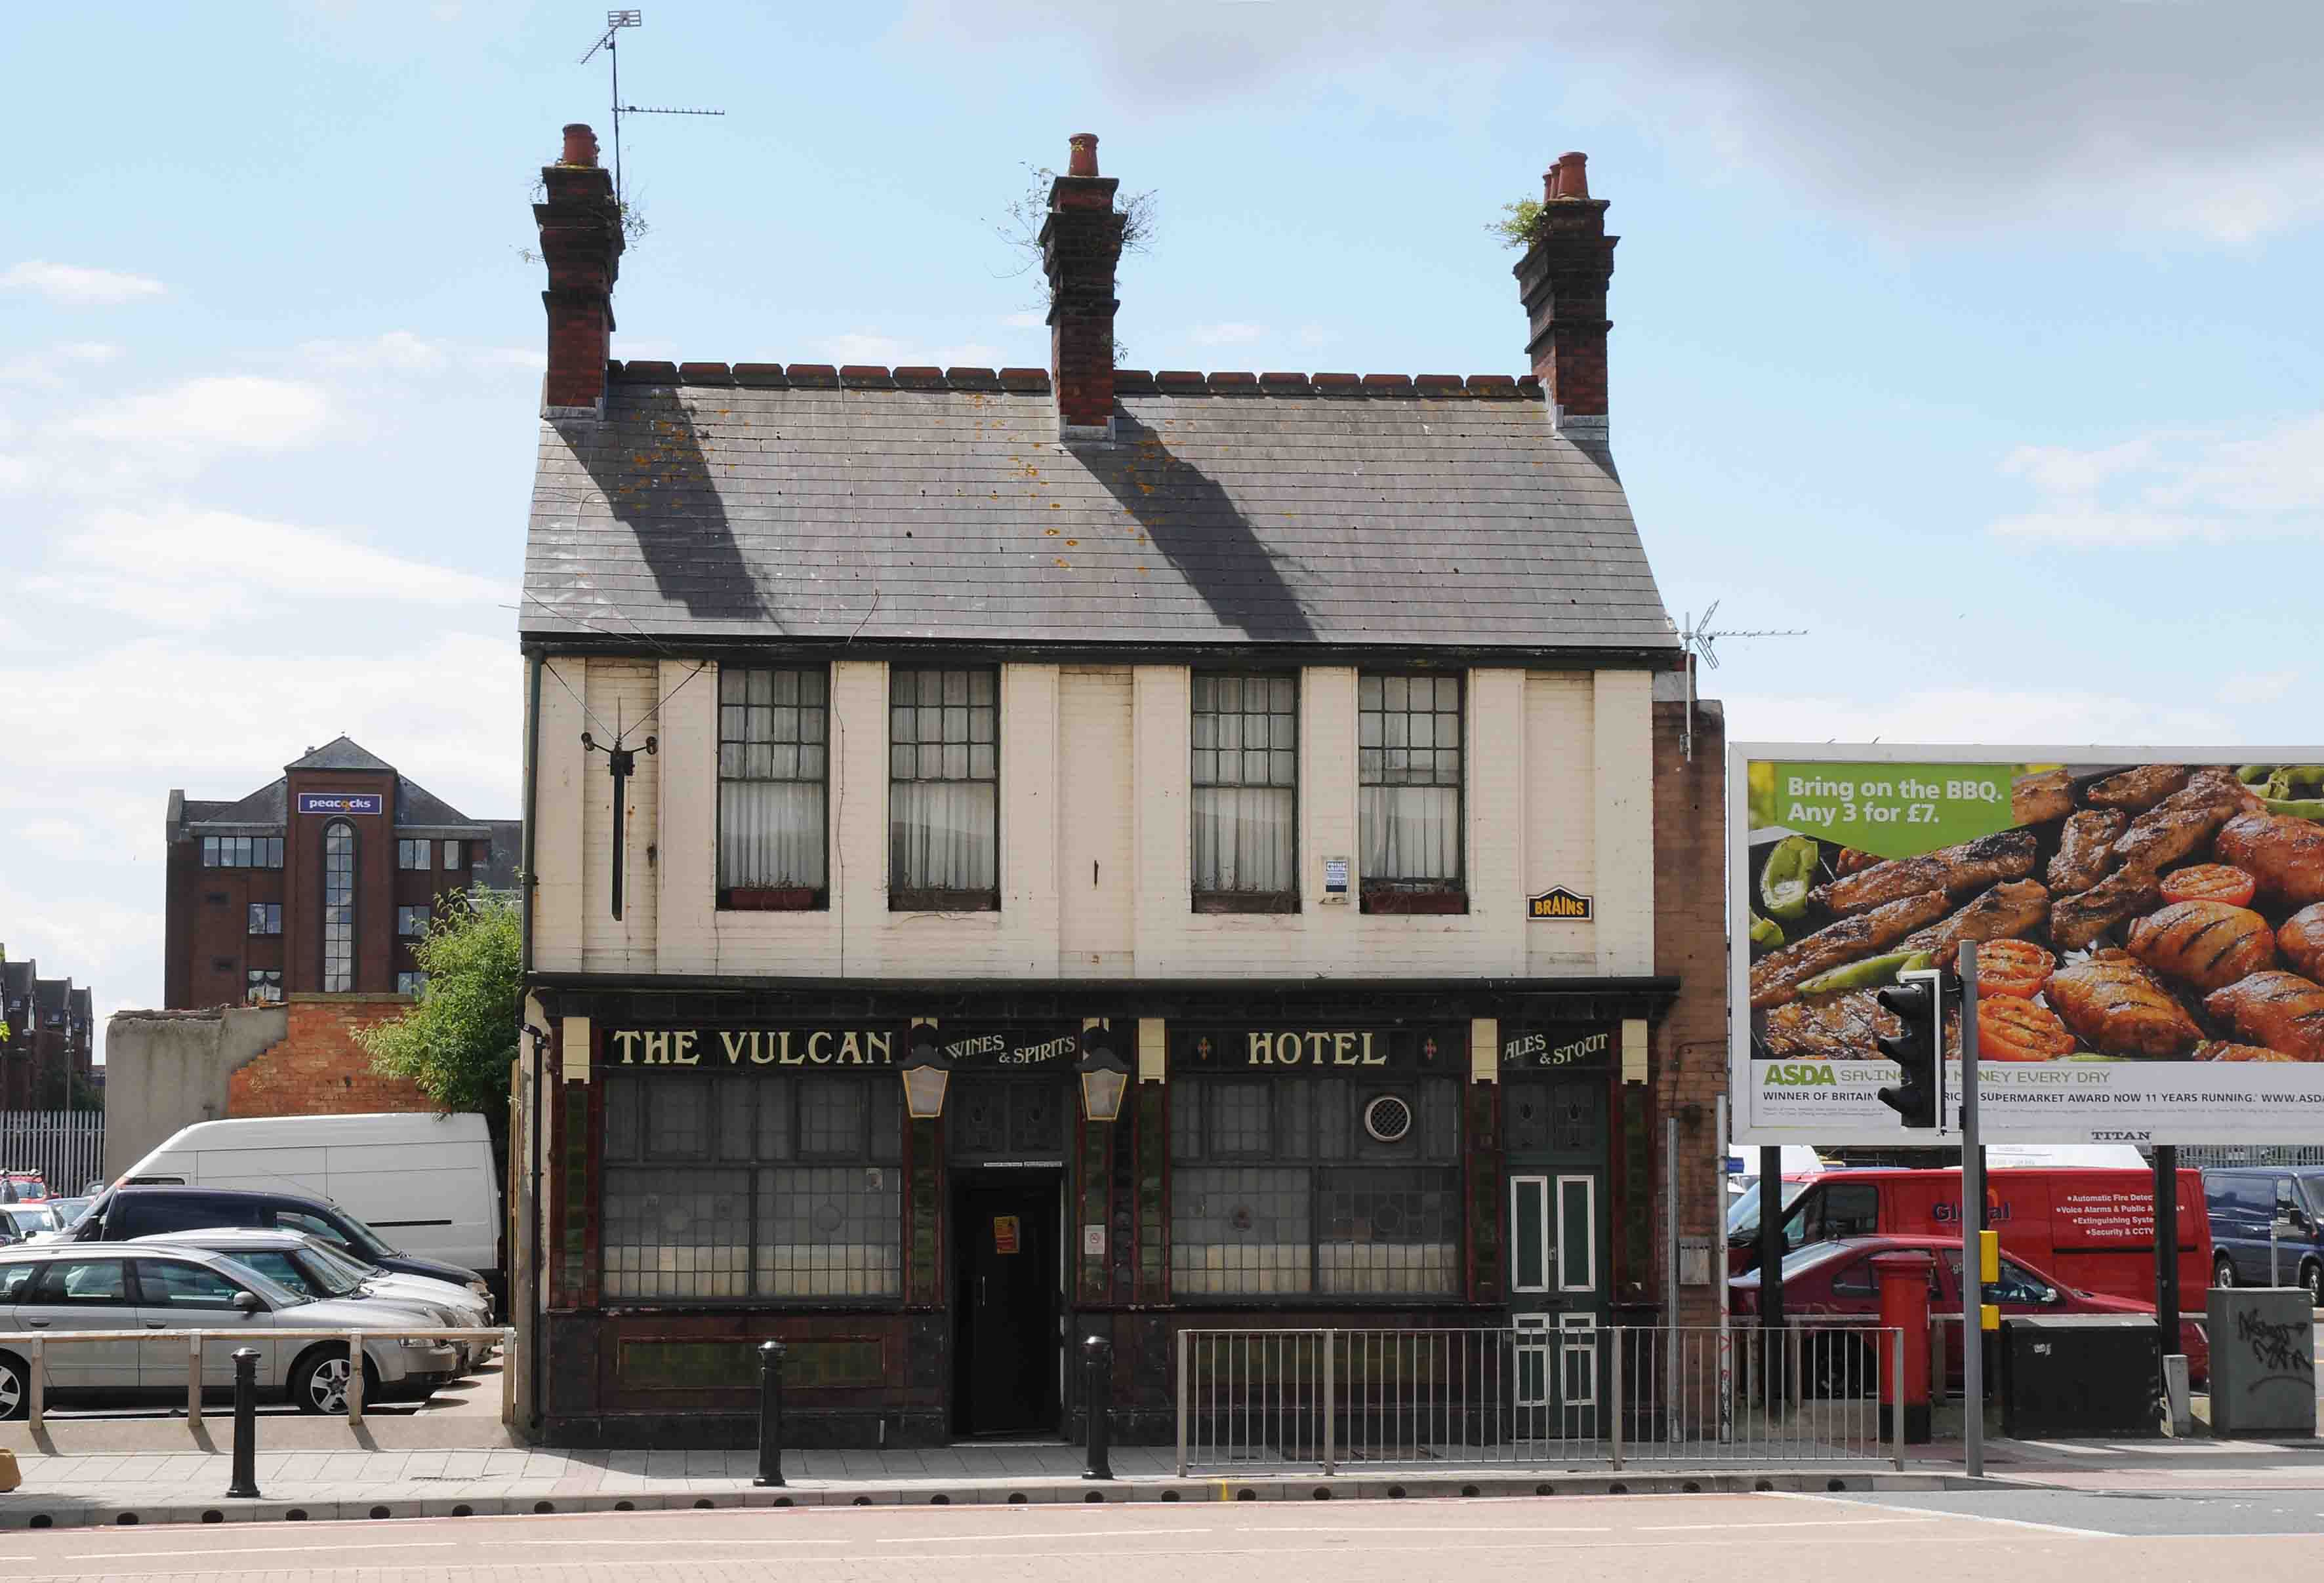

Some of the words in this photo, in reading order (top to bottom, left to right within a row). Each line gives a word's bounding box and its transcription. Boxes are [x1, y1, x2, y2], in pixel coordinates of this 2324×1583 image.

[1787, 777, 1854, 802] Bring
[1861, 783, 1892, 797] on
[1899, 780, 1940, 799] the
[1946, 781, 2003, 803] BBQ.
[309, 799, 371, 811] peacocks
[1787, 803, 1837, 826] Any
[1843, 804, 1857, 822] 3
[1863, 803, 1900, 822] for
[1907, 804, 1939, 823] £7.
[1535, 895, 1585, 915] BRAINS
[614, 1030, 701, 1066] THE
[720, 1031, 893, 1066] VULCAN
[945, 1034, 1006, 1060] WINES
[999, 1052, 1011, 1065] &
[1013, 1035, 1076, 1064] SPIRITS
[1248, 1032, 1387, 1066] HOTEL
[1503, 1033, 1547, 1061] ALES
[1539, 1052, 1552, 1065] &
[1553, 1033, 1609, 1065] STOUT
[1763, 1064, 1837, 1086] ASDA
[2018, 1070, 2071, 1083] EVERY
[2077, 1070, 2111, 1083] DAY
[1763, 1092, 1809, 1101] WINNER
[1813, 1092, 1828, 1101] OF
[1831, 1092, 1877, 1102] BRITAIN'
[1980, 1092, 2064, 1103] SUPERMARKET
[2068, 1093, 2110, 1103] AWARD
[2113, 1092, 2141, 1102] NOW
[2146, 1093, 2157, 1102] 11
[2161, 1093, 2198, 1102] YEARS
[2091, 1131, 2151, 1140] TITAN
[2090, 1228, 2123, 1237] Security
